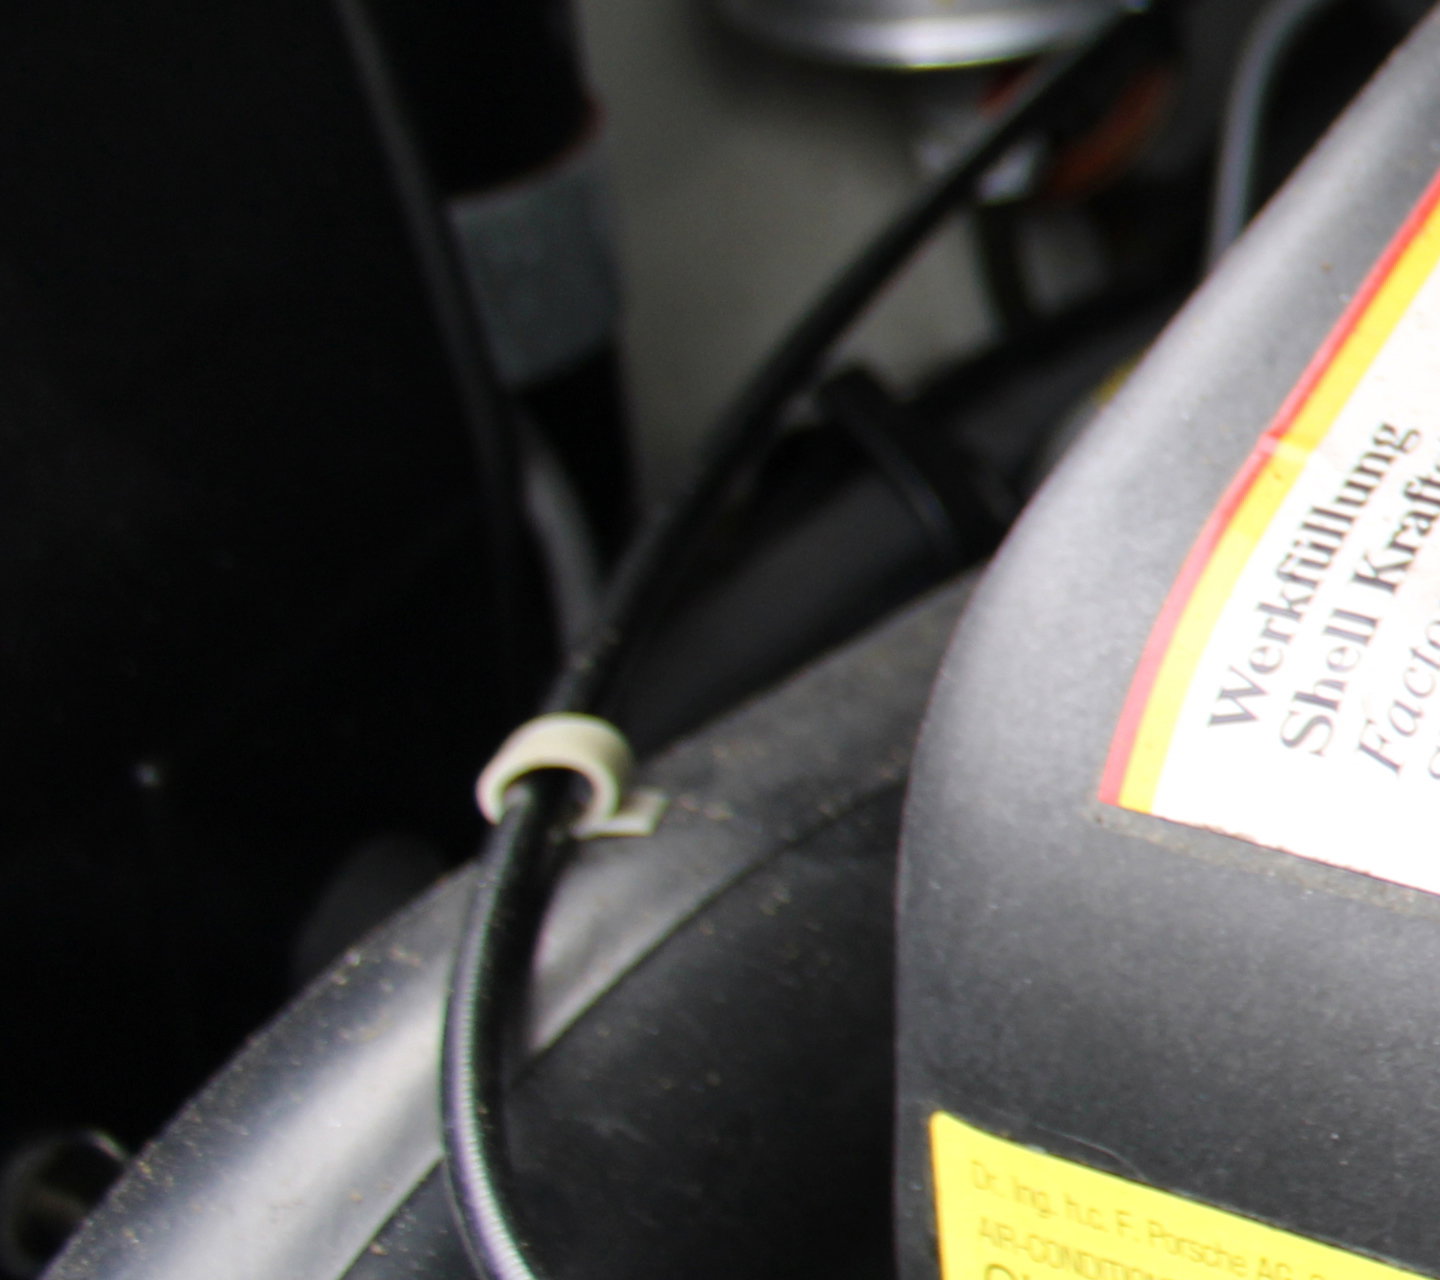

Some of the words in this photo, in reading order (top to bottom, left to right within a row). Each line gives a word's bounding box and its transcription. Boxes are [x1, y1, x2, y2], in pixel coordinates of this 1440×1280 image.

[1207, 421, 1422, 727] Werkfüllung
[1280, 608, 1382, 757] Shell
[1147, 1220, 1247, 1277] Porsche
